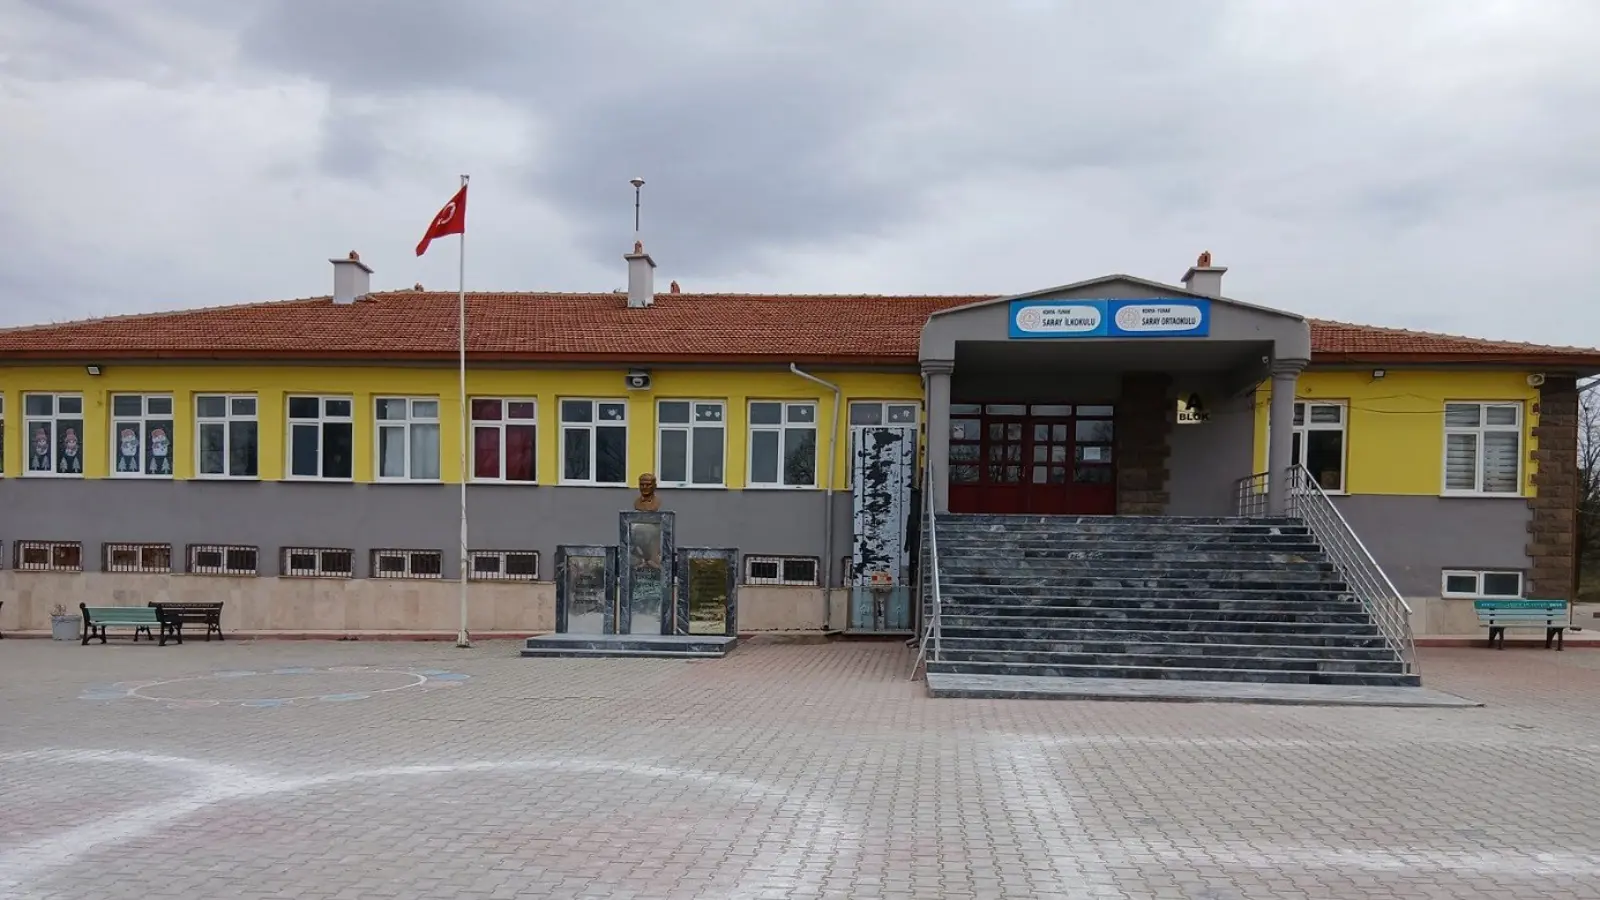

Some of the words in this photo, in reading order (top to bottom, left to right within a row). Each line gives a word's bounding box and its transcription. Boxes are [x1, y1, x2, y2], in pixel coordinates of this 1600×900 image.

[1042, 318, 1062, 326] SARAY
[1065, 317, 1096, 327] İLKOKULU
[1142, 317, 1160, 326] SARAY
[1161, 316, 1196, 325] ORTAOKULU
[1185, 392, 1204, 410] A
[1179, 412, 1210, 421] BLOK
